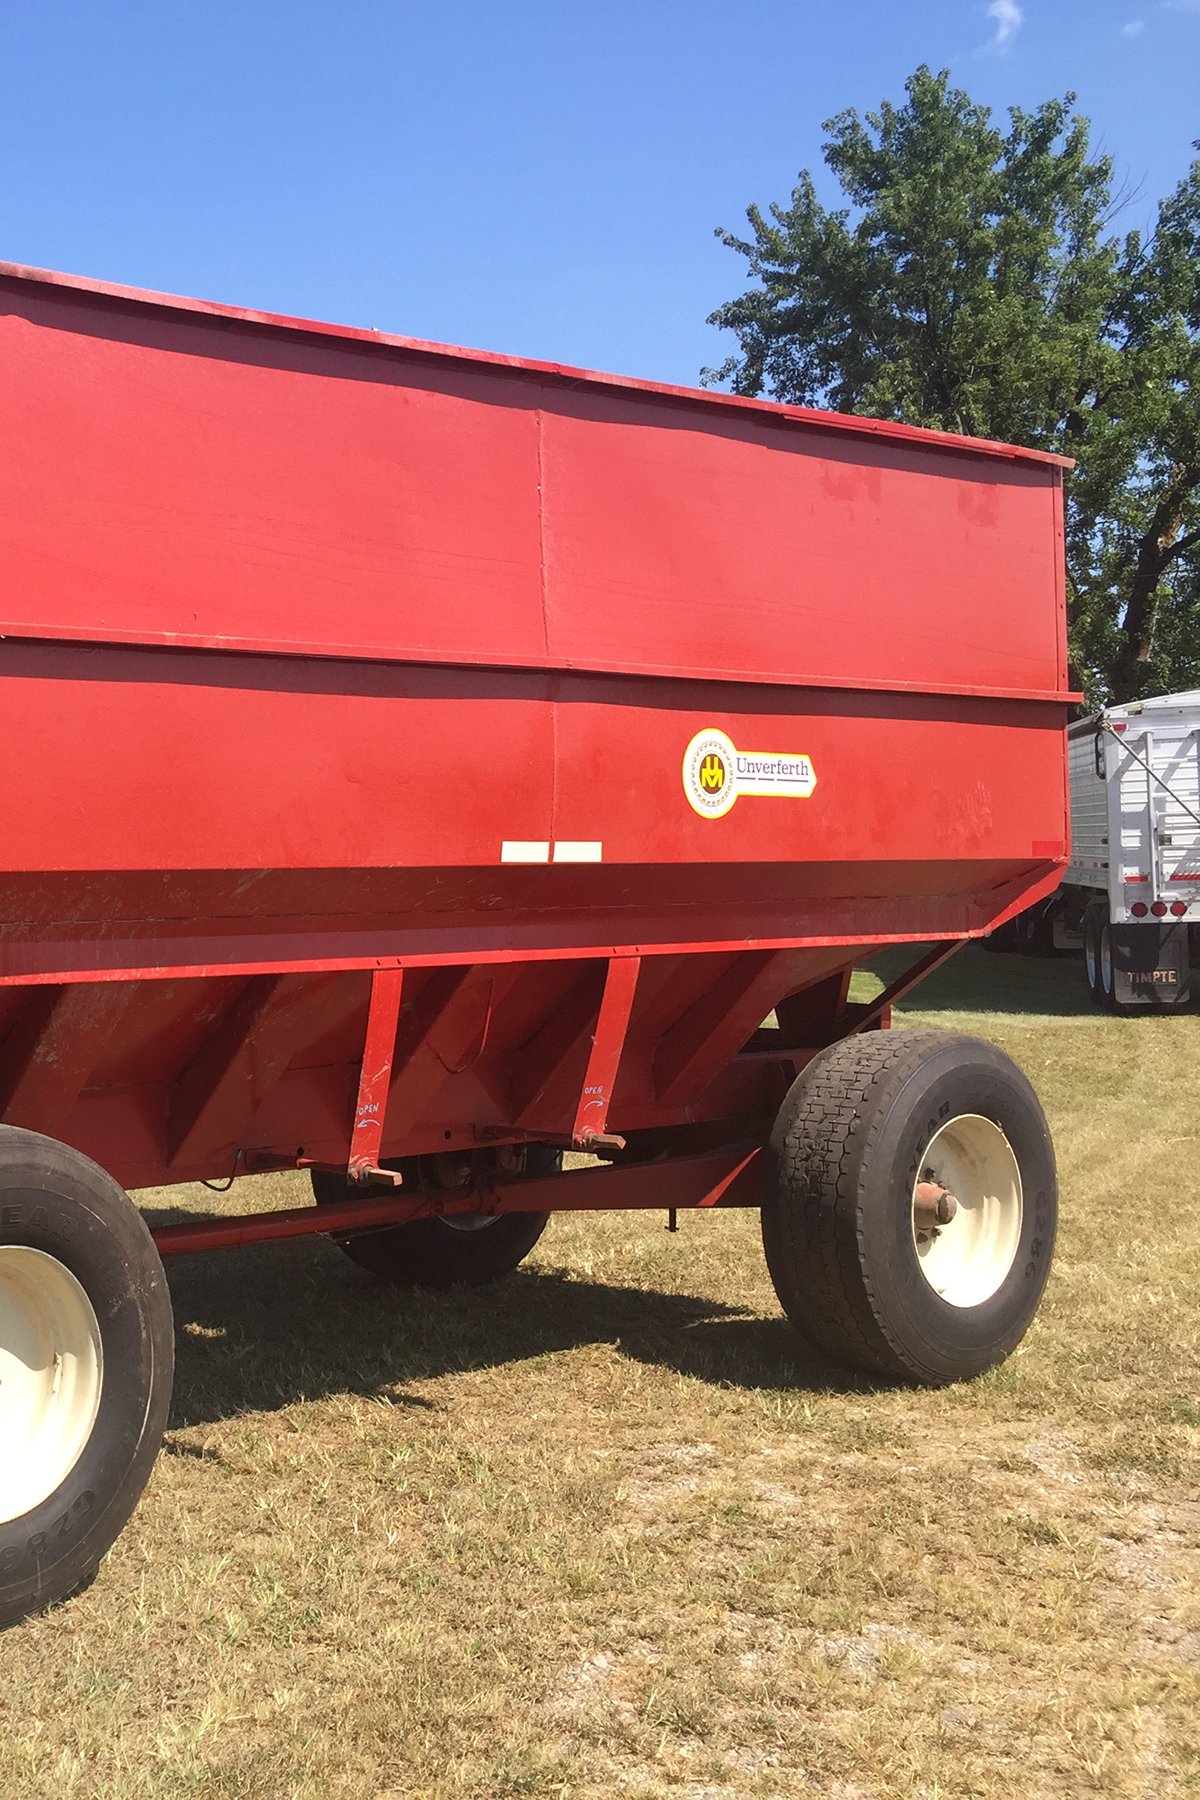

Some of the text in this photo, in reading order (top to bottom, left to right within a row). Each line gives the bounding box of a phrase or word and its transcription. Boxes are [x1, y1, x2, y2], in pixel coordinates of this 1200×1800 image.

[735, 757, 809, 776] Unverferth
[1126, 970, 1177, 983] TIMPTE
[584, 1086, 603, 1095] OPEN
[358, 1103, 379, 1116] OPEN
